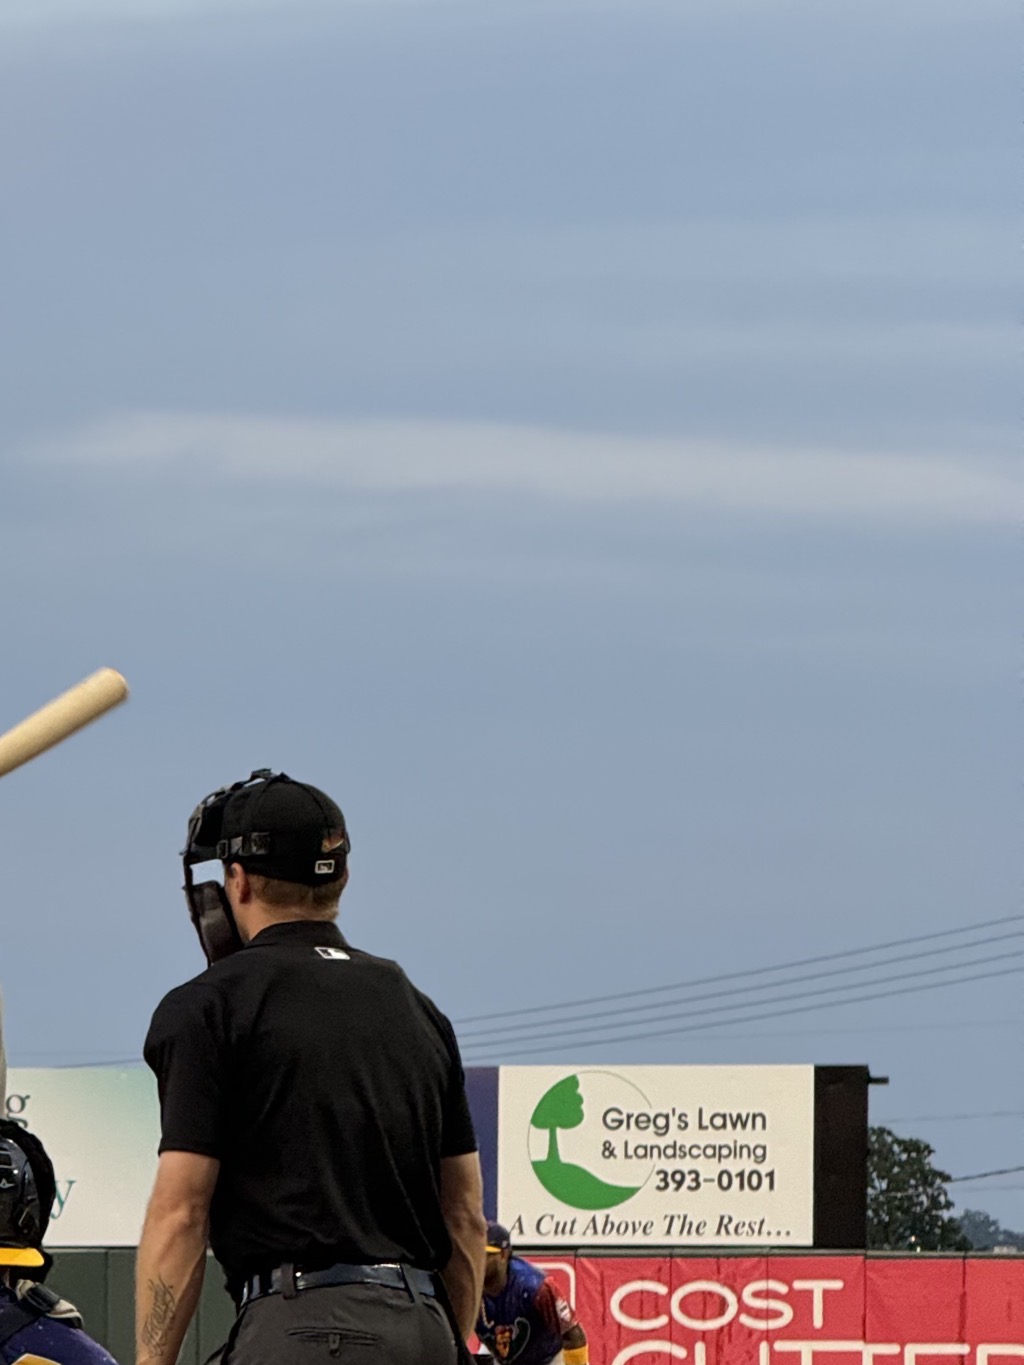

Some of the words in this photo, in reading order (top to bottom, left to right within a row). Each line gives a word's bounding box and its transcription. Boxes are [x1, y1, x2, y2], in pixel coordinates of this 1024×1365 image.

[602, 1107, 689, 1137] Greg's
[698, 1107, 767, 1131] Lawn
[601, 1140, 617, 1160] &
[624, 1140, 767, 1165] Landscaping
[655, 1169, 775, 1192] 393-0101
[510, 1215, 525, 1236] A
[535, 1213, 576, 1236] Cut
[583, 1213, 654, 1236] Above
[664, 1213, 707, 1236] The
[715, 1213, 792, 1237] Rest...
[610, 1280, 844, 1330] COST
